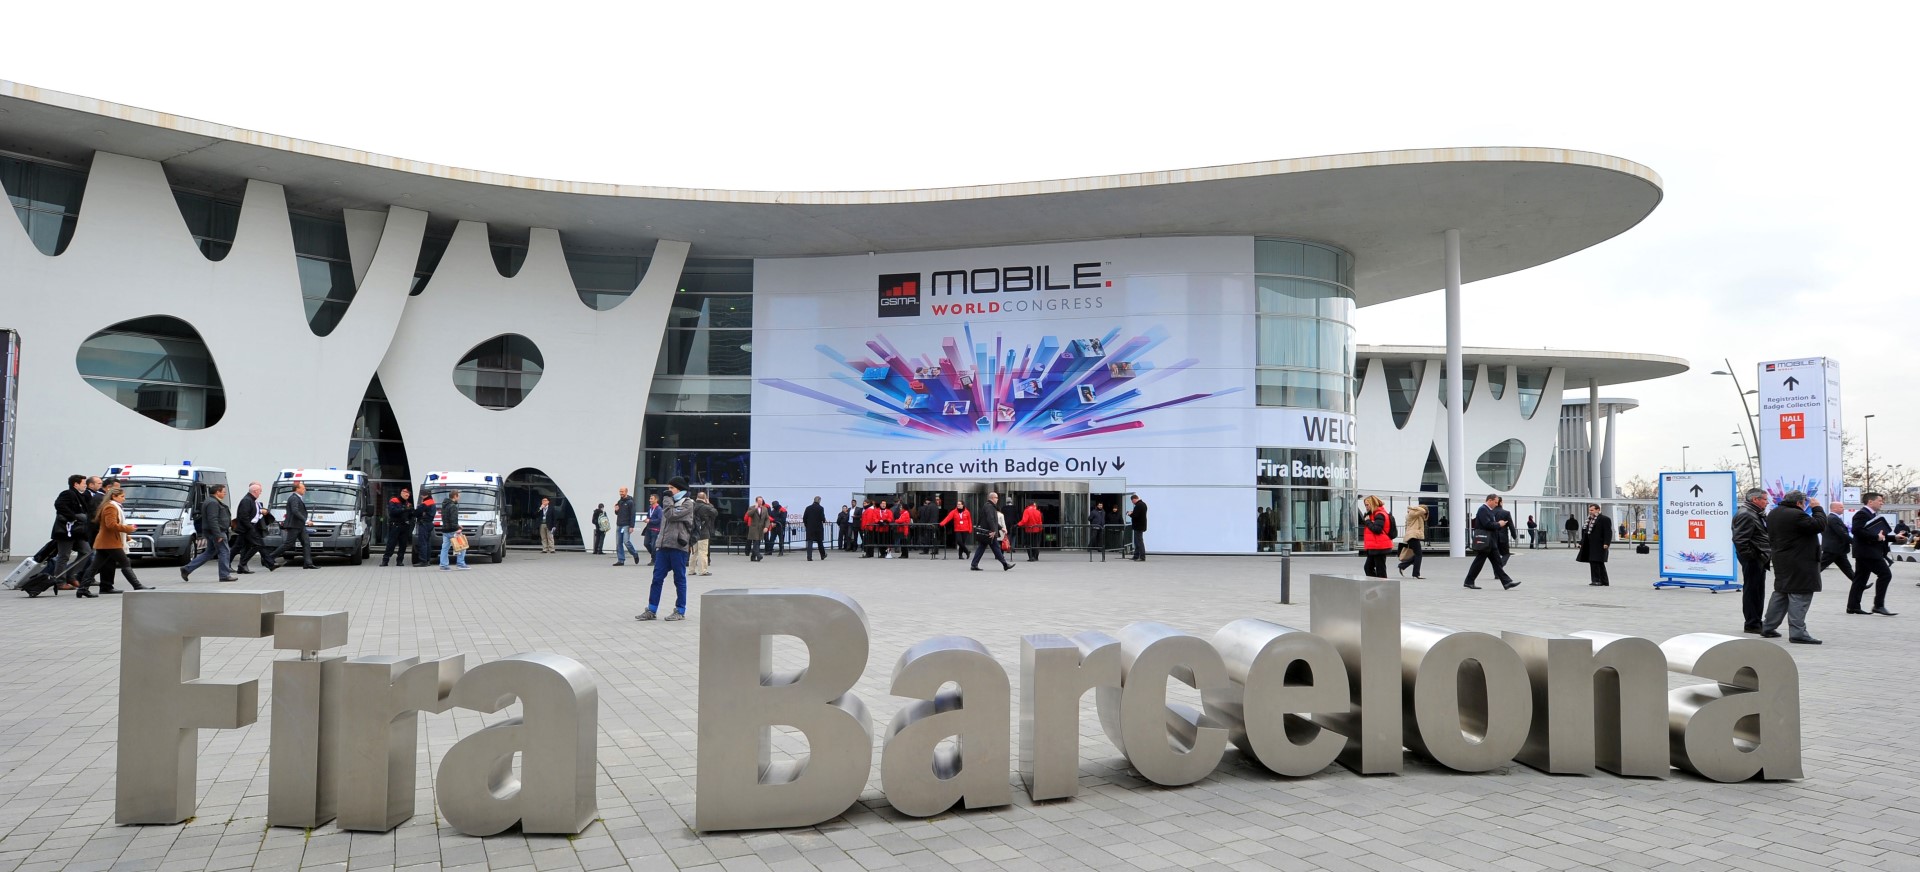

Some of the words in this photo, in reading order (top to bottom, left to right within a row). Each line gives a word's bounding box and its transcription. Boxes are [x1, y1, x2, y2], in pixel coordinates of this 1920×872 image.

[880, 297, 916, 306] GSMA
[1767, 395, 1809, 404] Registration
[1786, 401, 1821, 409] Collection
[1787, 424, 1797, 437] 1
[881, 460, 954, 475] Entrance
[959, 458, 998, 474] with
[1005, 458, 1059, 476] Badge
[1065, 457, 1108, 475] Only
[1256, 459, 1289, 477] Fira
[1291, 460, 1349, 480] Barcelona
[1670, 500, 1715, 508] Registration
[1693, 528, 1700, 537] 1
[115, 590, 598, 837] Fira
[695, 574, 1804, 833] Barcelona
